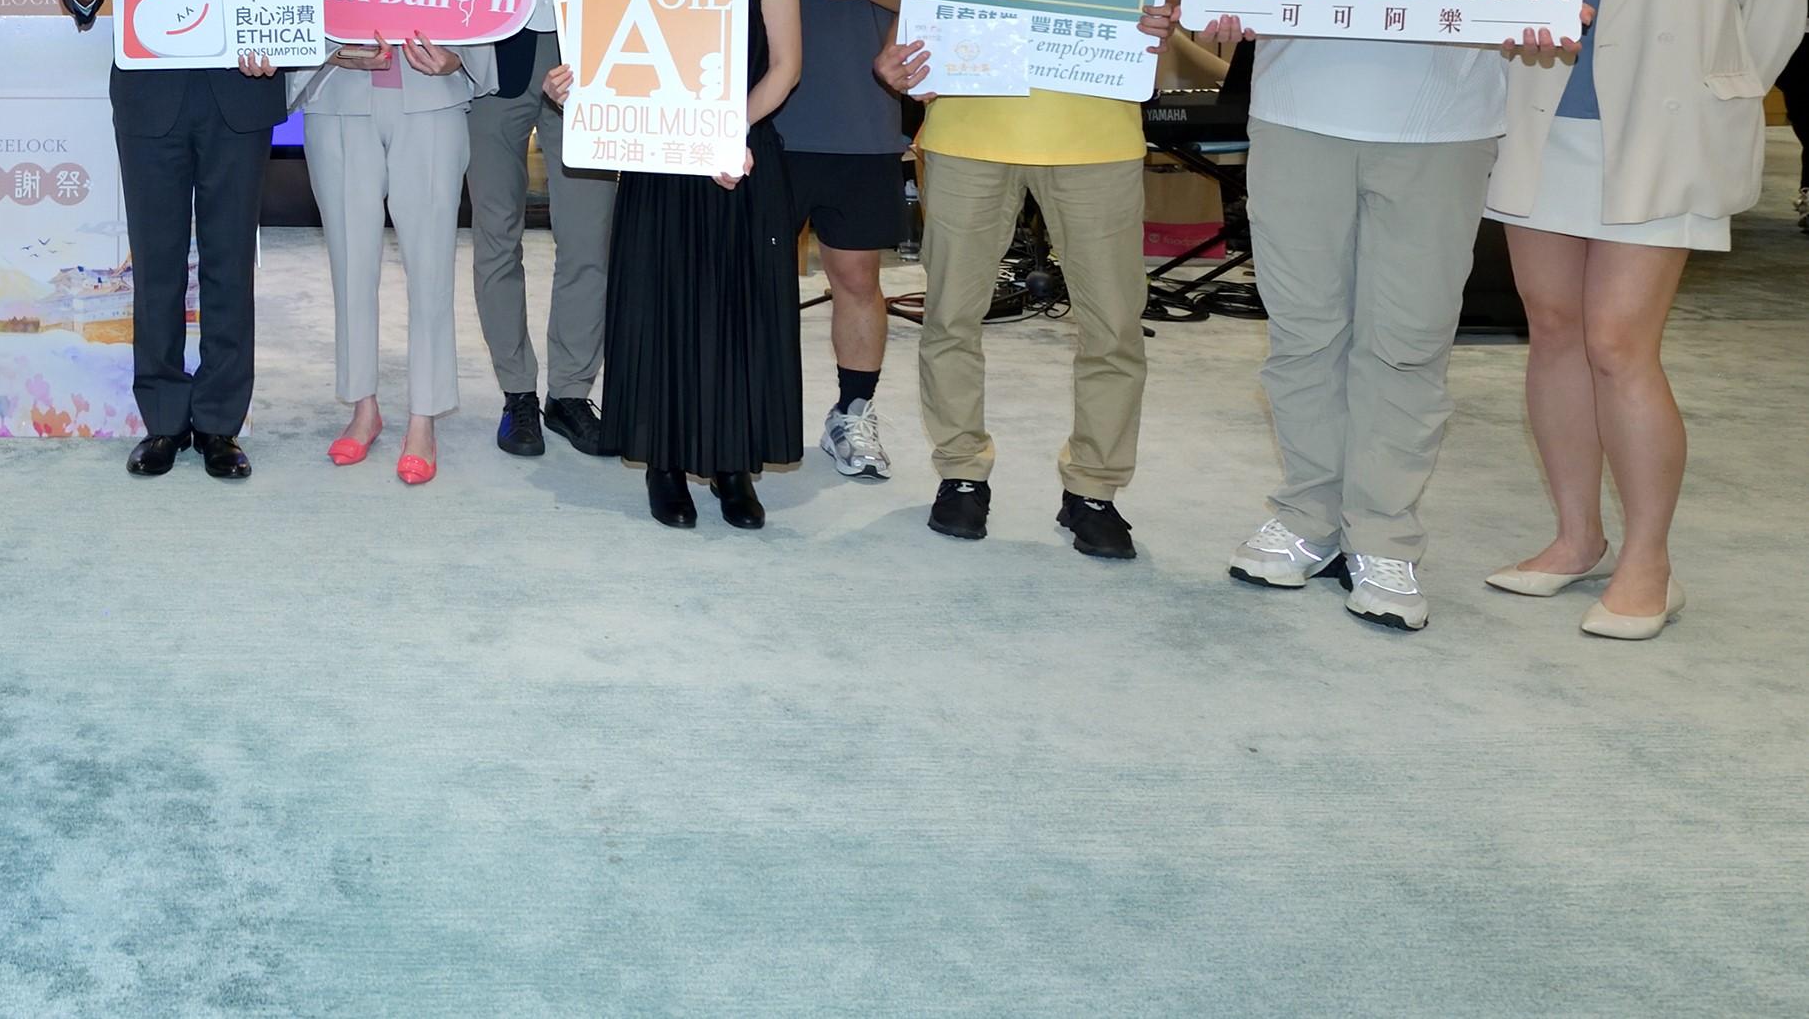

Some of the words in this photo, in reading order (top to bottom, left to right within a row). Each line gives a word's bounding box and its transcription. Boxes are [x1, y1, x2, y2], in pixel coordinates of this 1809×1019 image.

[236, 5, 316, 27] 良心消費
[1280, 2, 1463, 34] 可可阿樂
[237, 28, 316, 45] ETHICAL
[237, 46, 317, 57] CONSUMPTION
[1036, 39, 1144, 64] employment
[1029, 63, 1127, 87] enrichment
[571, 102, 739, 139] ADDOILMUSIC
[1146, 108, 1188, 122] YAMAHA
